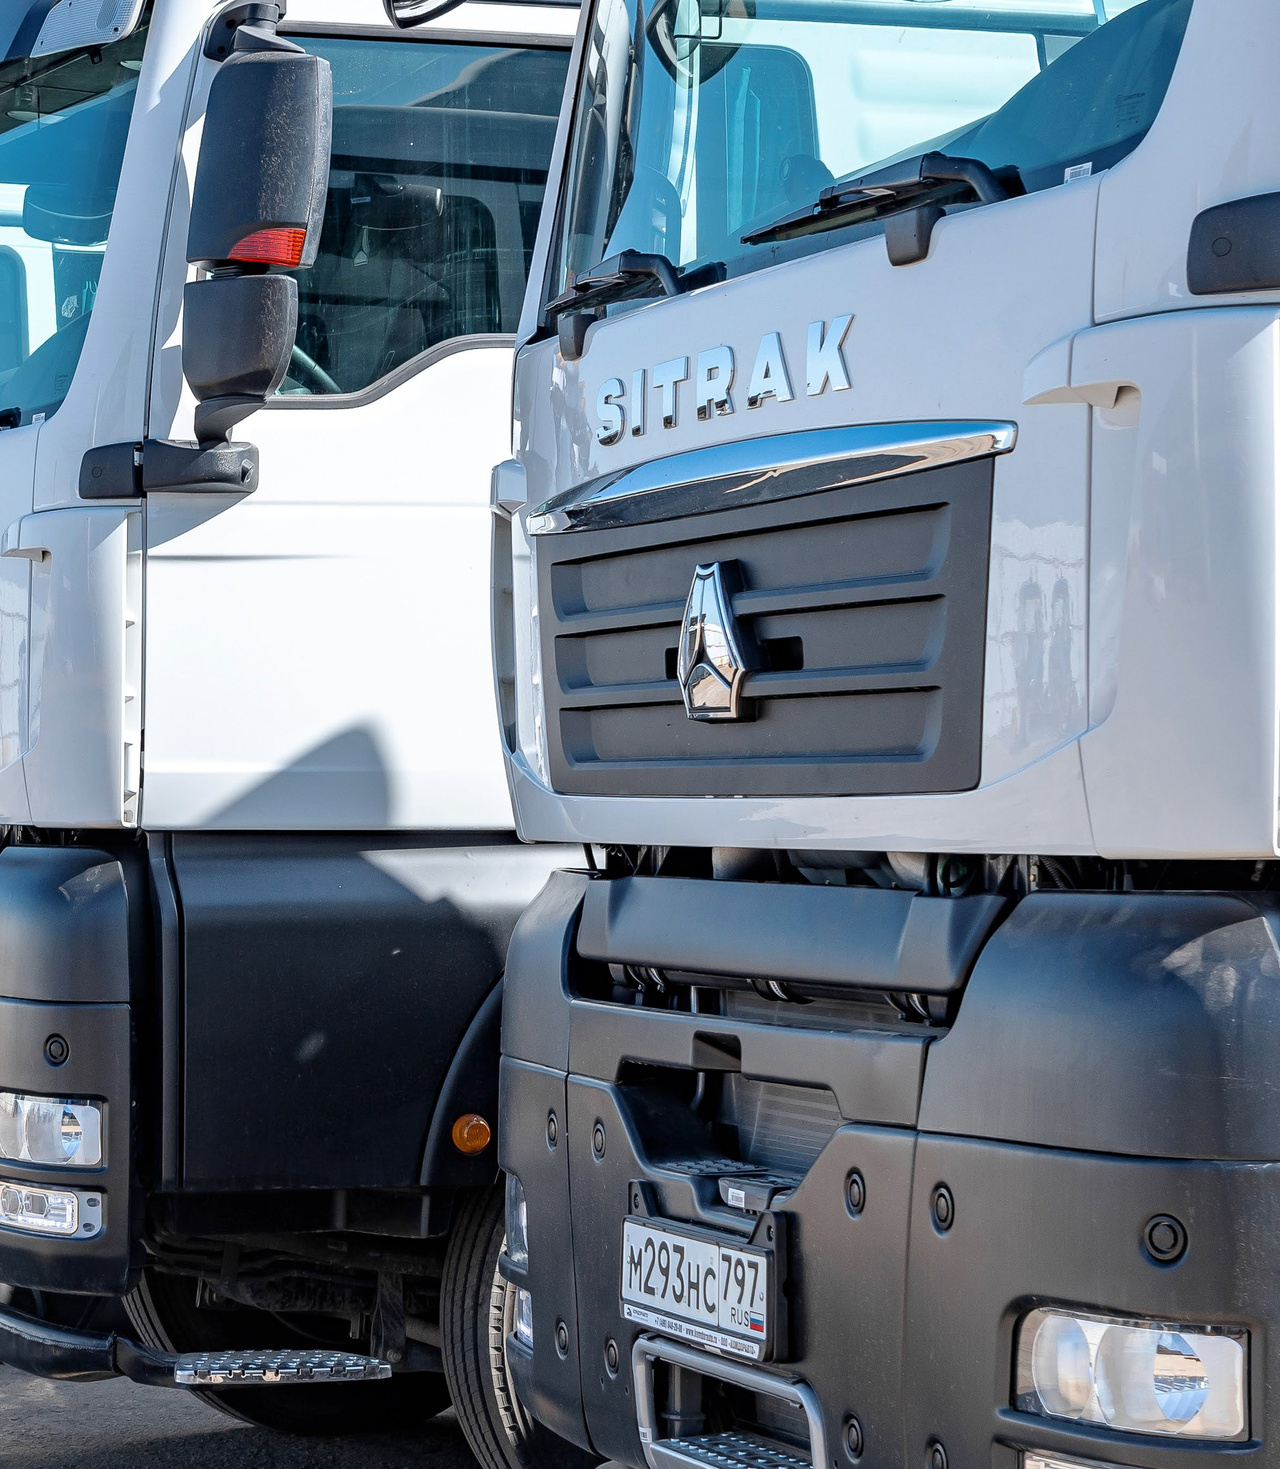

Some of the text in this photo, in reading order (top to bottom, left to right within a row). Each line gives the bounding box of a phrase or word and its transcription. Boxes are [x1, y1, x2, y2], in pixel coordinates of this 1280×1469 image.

[596, 314, 855, 446] SITRAK
[629, 1237, 759, 1314] М293НС 797
[730, 1307, 750, 1328] RUS
